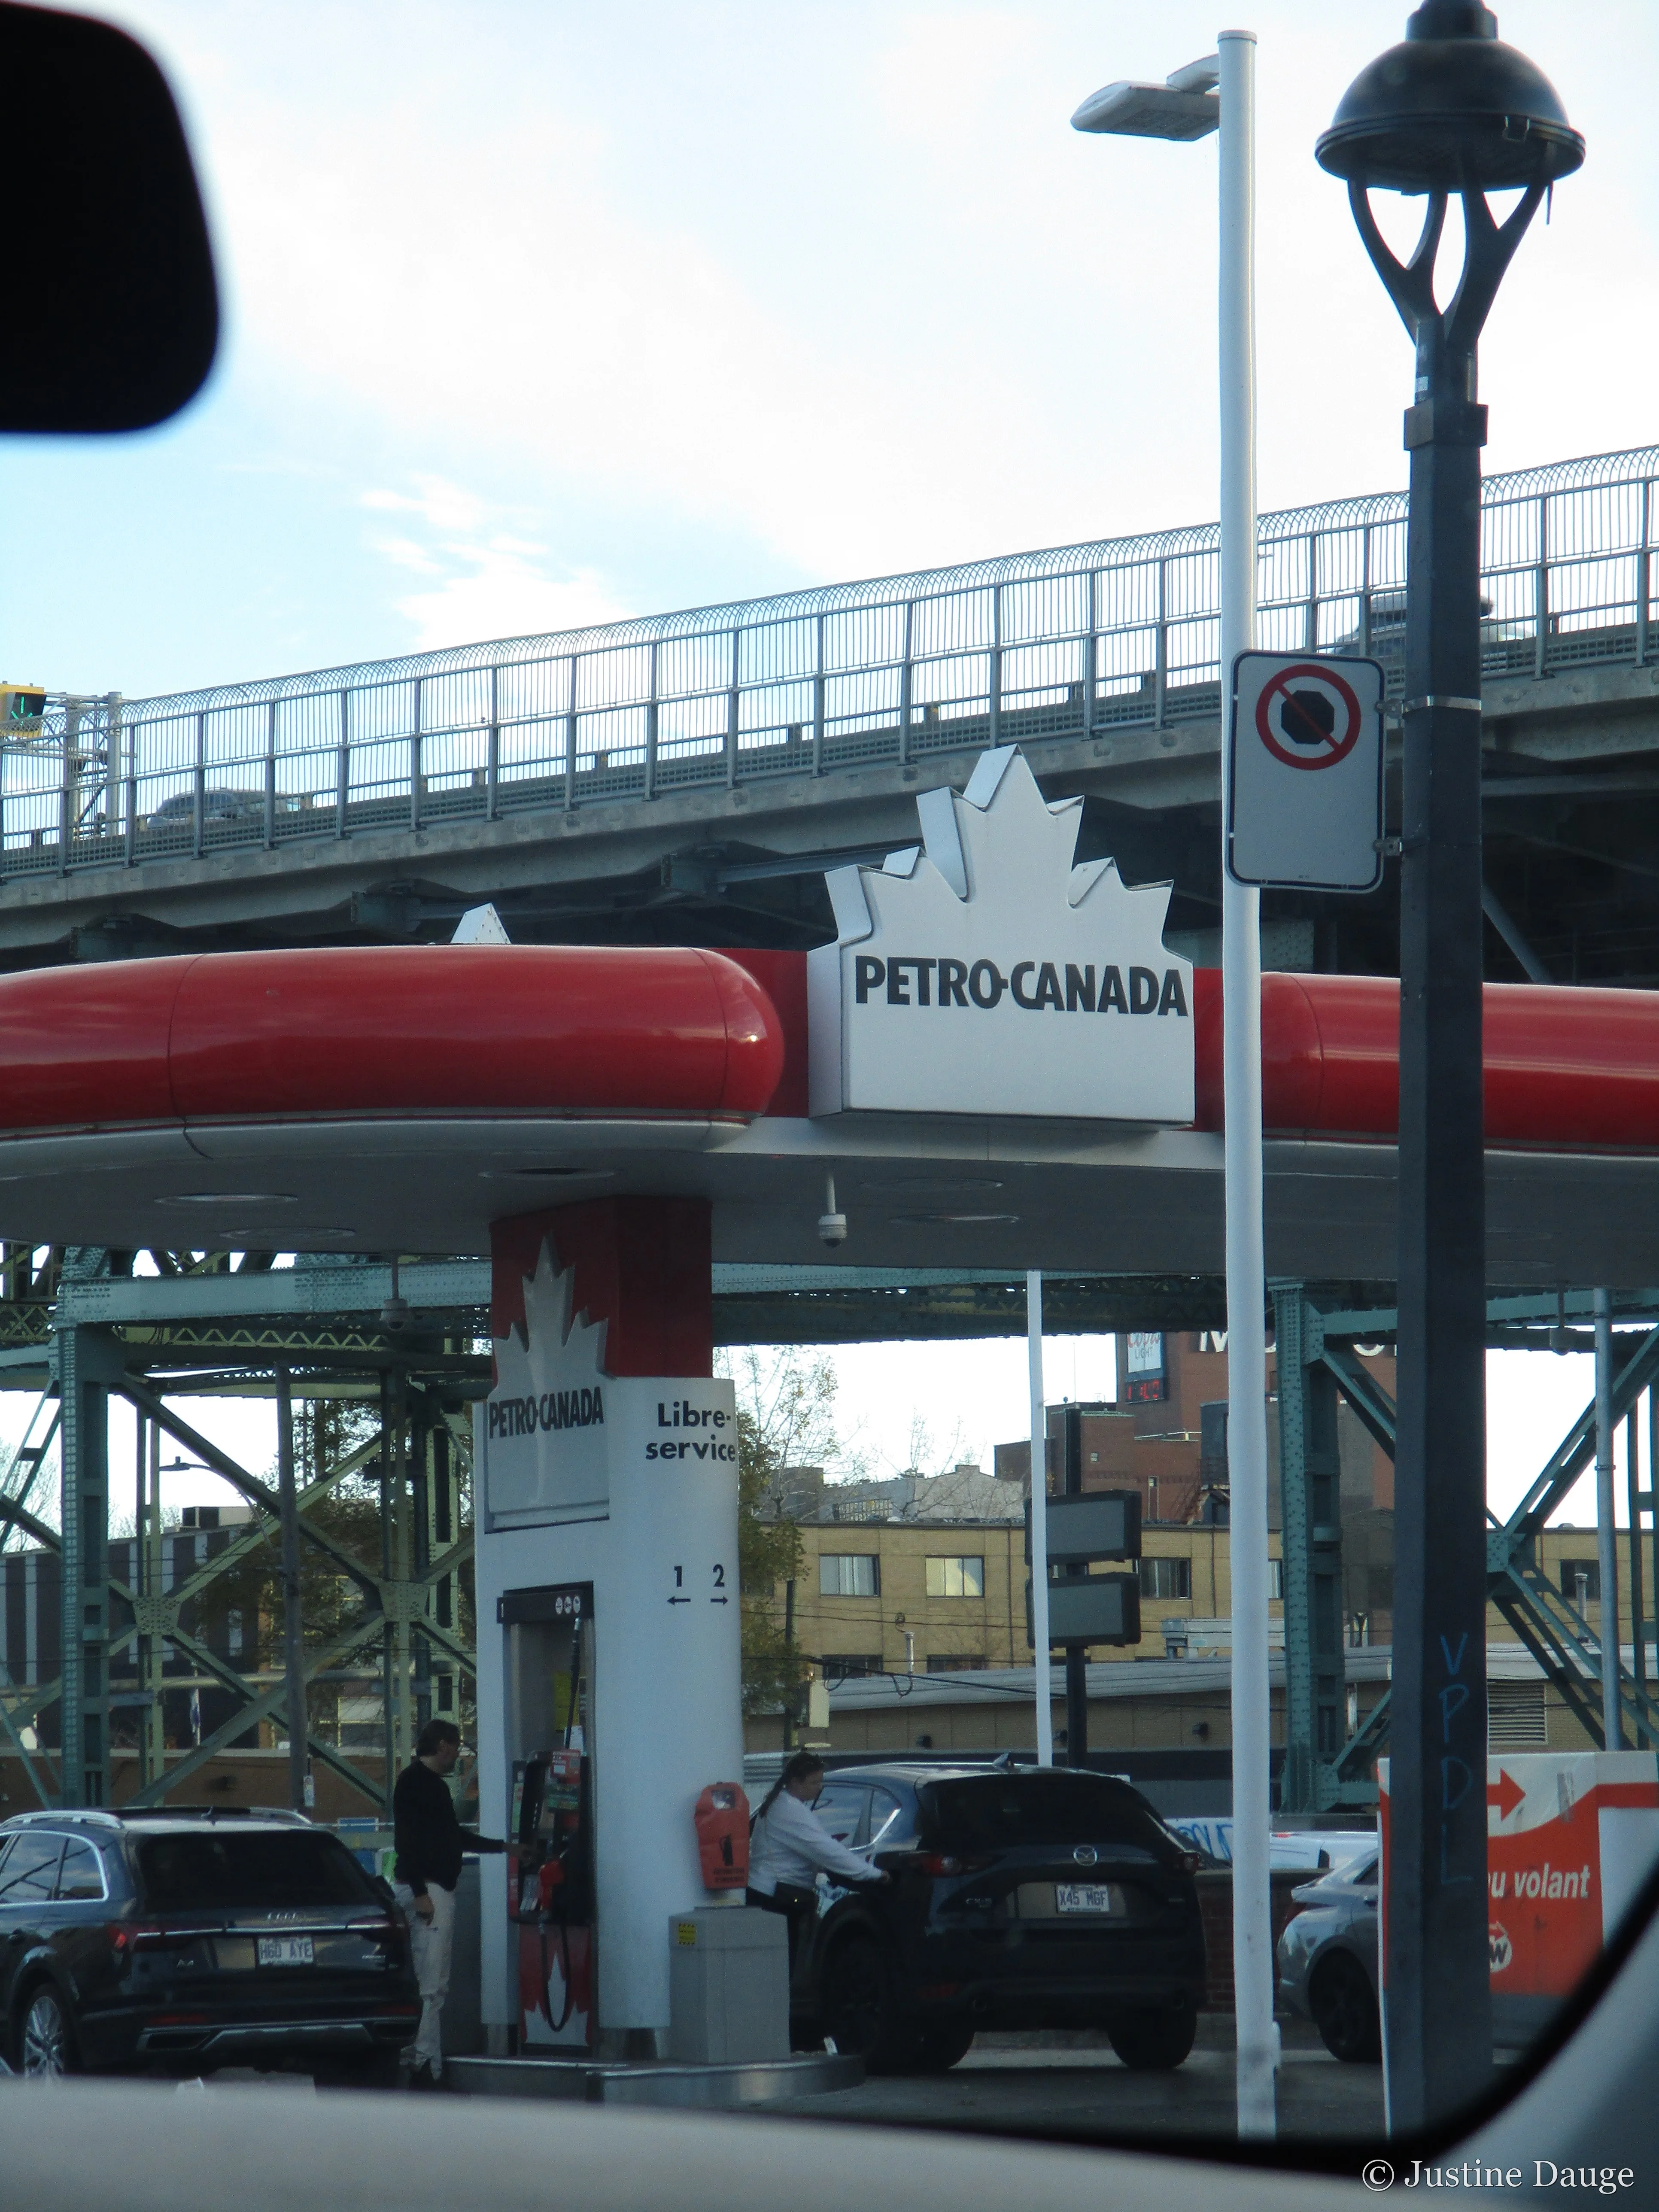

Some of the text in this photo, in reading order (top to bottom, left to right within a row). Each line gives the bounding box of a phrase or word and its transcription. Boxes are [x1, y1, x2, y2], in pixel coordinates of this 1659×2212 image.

[856, 955, 1188, 1017] PETRO-CANADA
[657, 1401, 732, 1428] Libre-
[645, 1434, 735, 1462] service
[674, 1564, 725, 1588] 1 2
[1487, 1862, 1590, 1899] u volant
